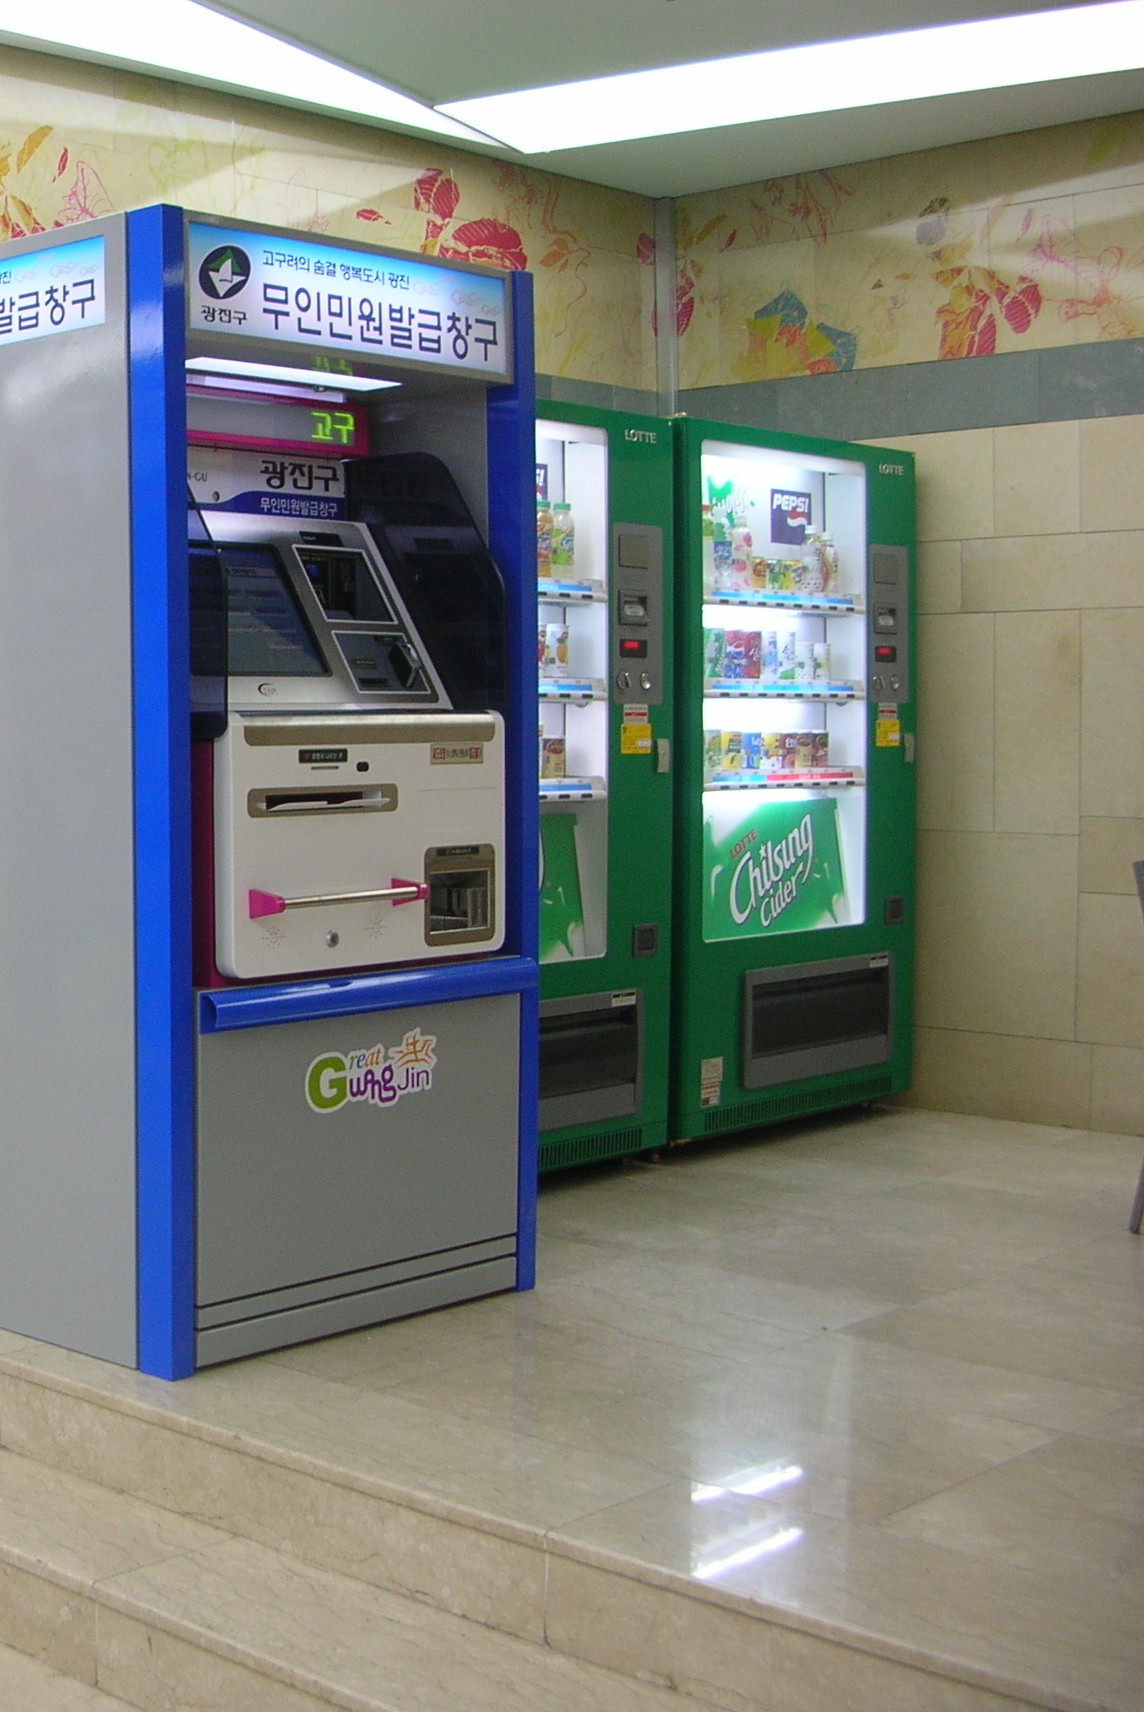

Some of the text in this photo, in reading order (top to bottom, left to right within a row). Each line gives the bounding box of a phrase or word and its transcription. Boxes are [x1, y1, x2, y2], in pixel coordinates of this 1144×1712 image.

[262, 250, 410, 290] 고구려의 숨결 행복도시 광진
[201, 305, 248, 326] 광진구
[262, 283, 498, 362] 무인민원발급창구
[311, 411, 355, 445] 고구
[625, 429, 657, 444] LOTTE
[260, 460, 340, 492] 광진구
[878, 463, 904, 476] LOTTE
[260, 497, 338, 517] 무인민원발급창구
[773, 493, 809, 512] PEPSI
[730, 828, 758, 859] LOTTE
[729, 813, 813, 925] Chilsung
[760, 861, 804, 927] Cider
